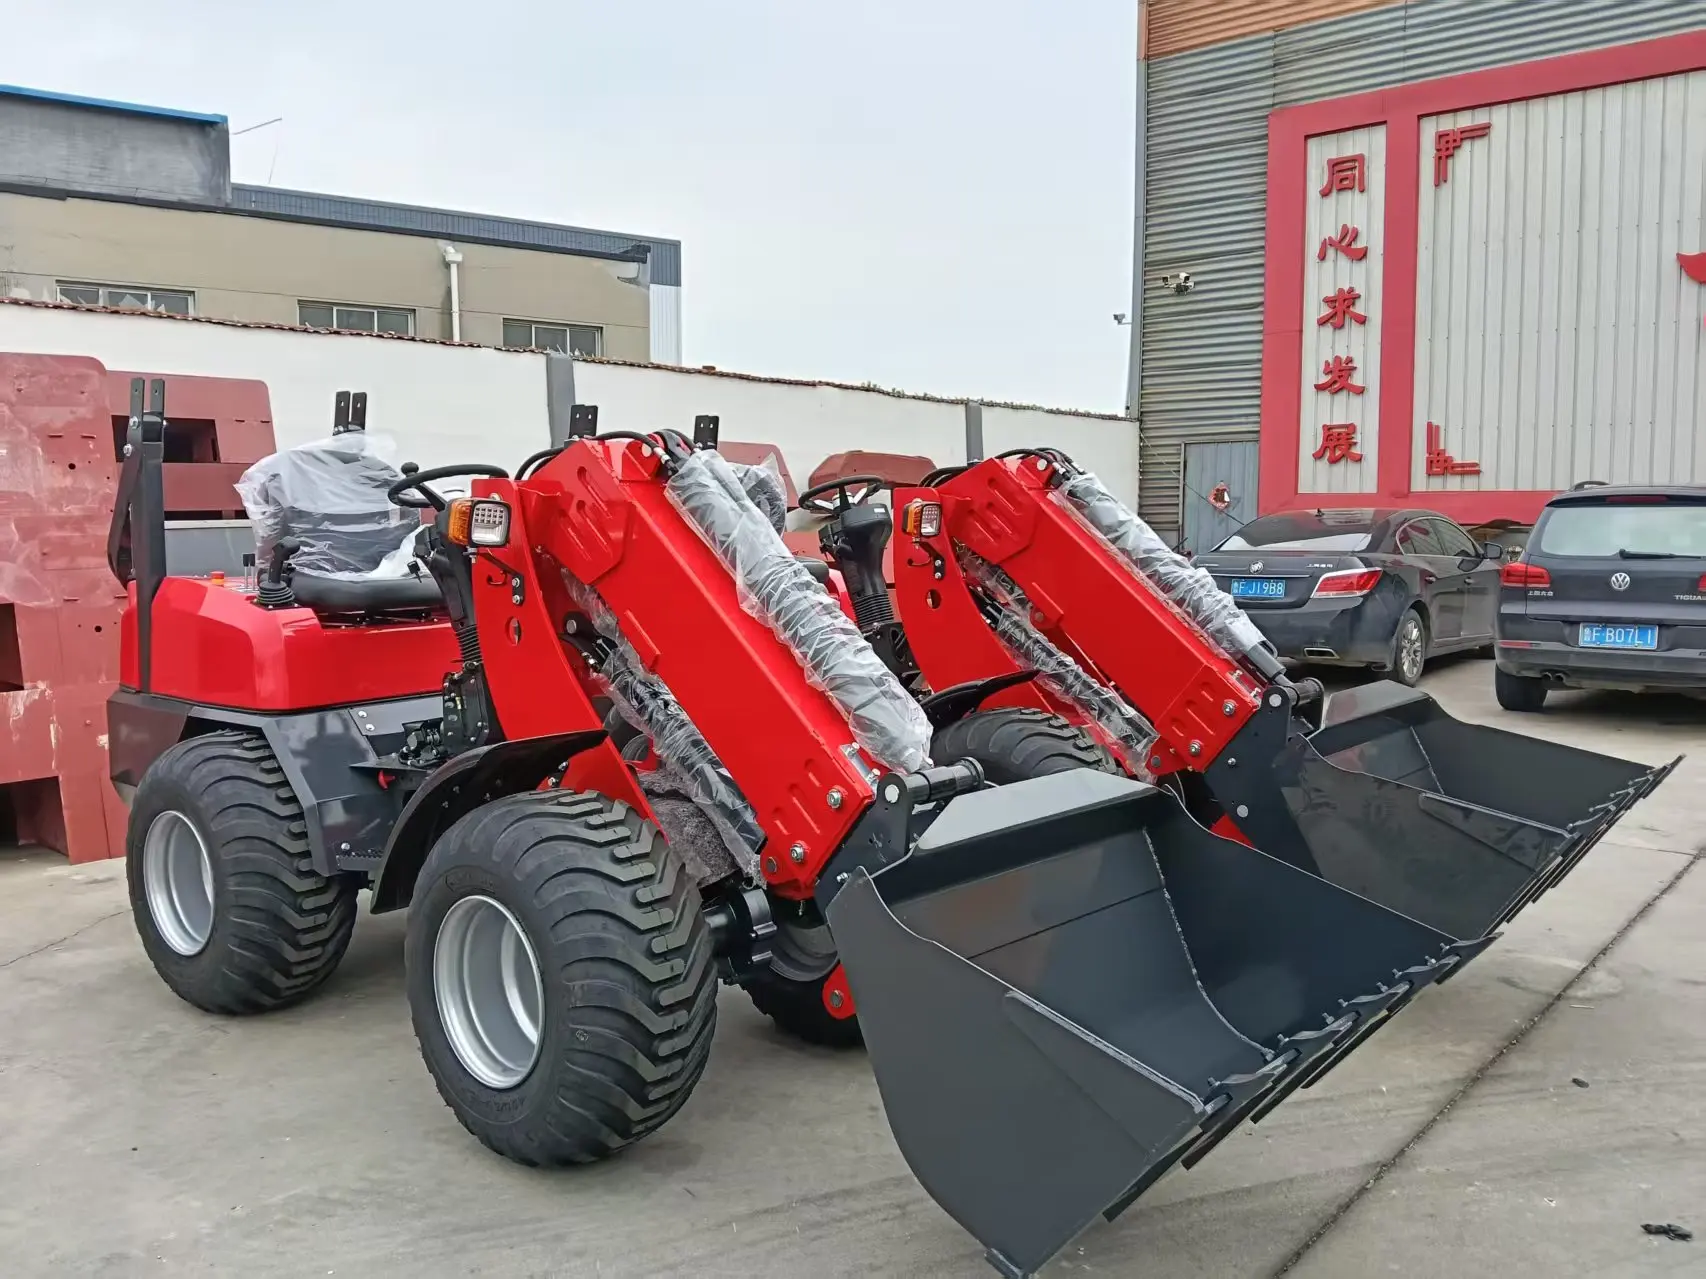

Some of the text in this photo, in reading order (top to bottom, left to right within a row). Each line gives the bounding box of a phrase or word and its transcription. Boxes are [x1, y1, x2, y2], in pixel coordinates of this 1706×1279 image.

[1312, 153, 1368, 464] 同心求发展
